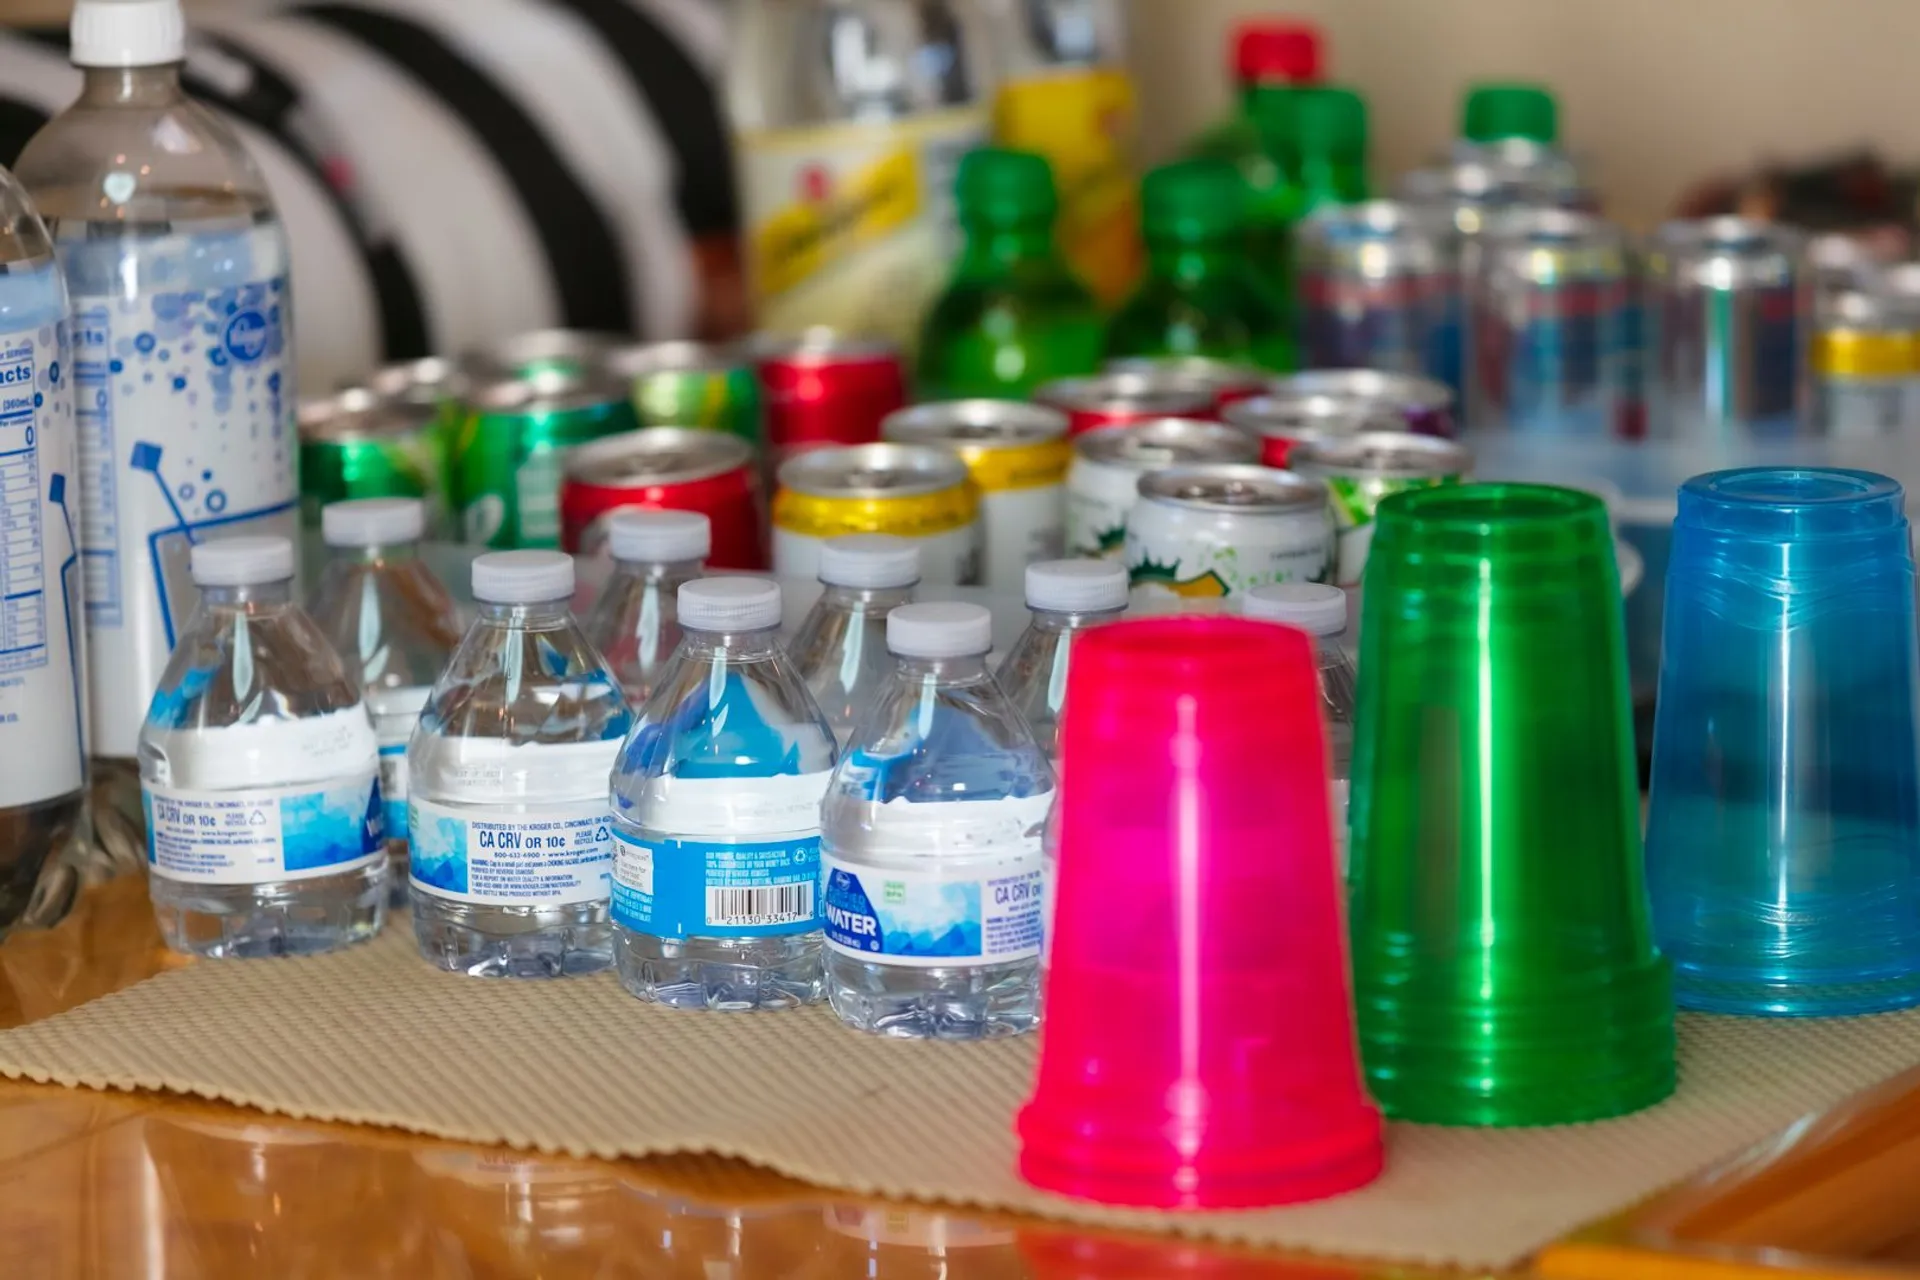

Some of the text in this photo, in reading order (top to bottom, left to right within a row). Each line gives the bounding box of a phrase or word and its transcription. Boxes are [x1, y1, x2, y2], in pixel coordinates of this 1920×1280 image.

[25, 425, 34, 446] 0
[182, 814, 195, 826] OR
[199, 815, 217, 827] 10¢
[529, 822, 552, 831] KROGER
[479, 830, 566, 849] CA CRV OR 10¢
[575, 829, 592, 838] PLEASE
[548, 847, 599, 858] www.kroger.com
[995, 886, 1009, 905] CA
[726, 914, 761, 926] 21130
[766, 911, 798, 924] 33417
[825, 902, 877, 938] WATER
